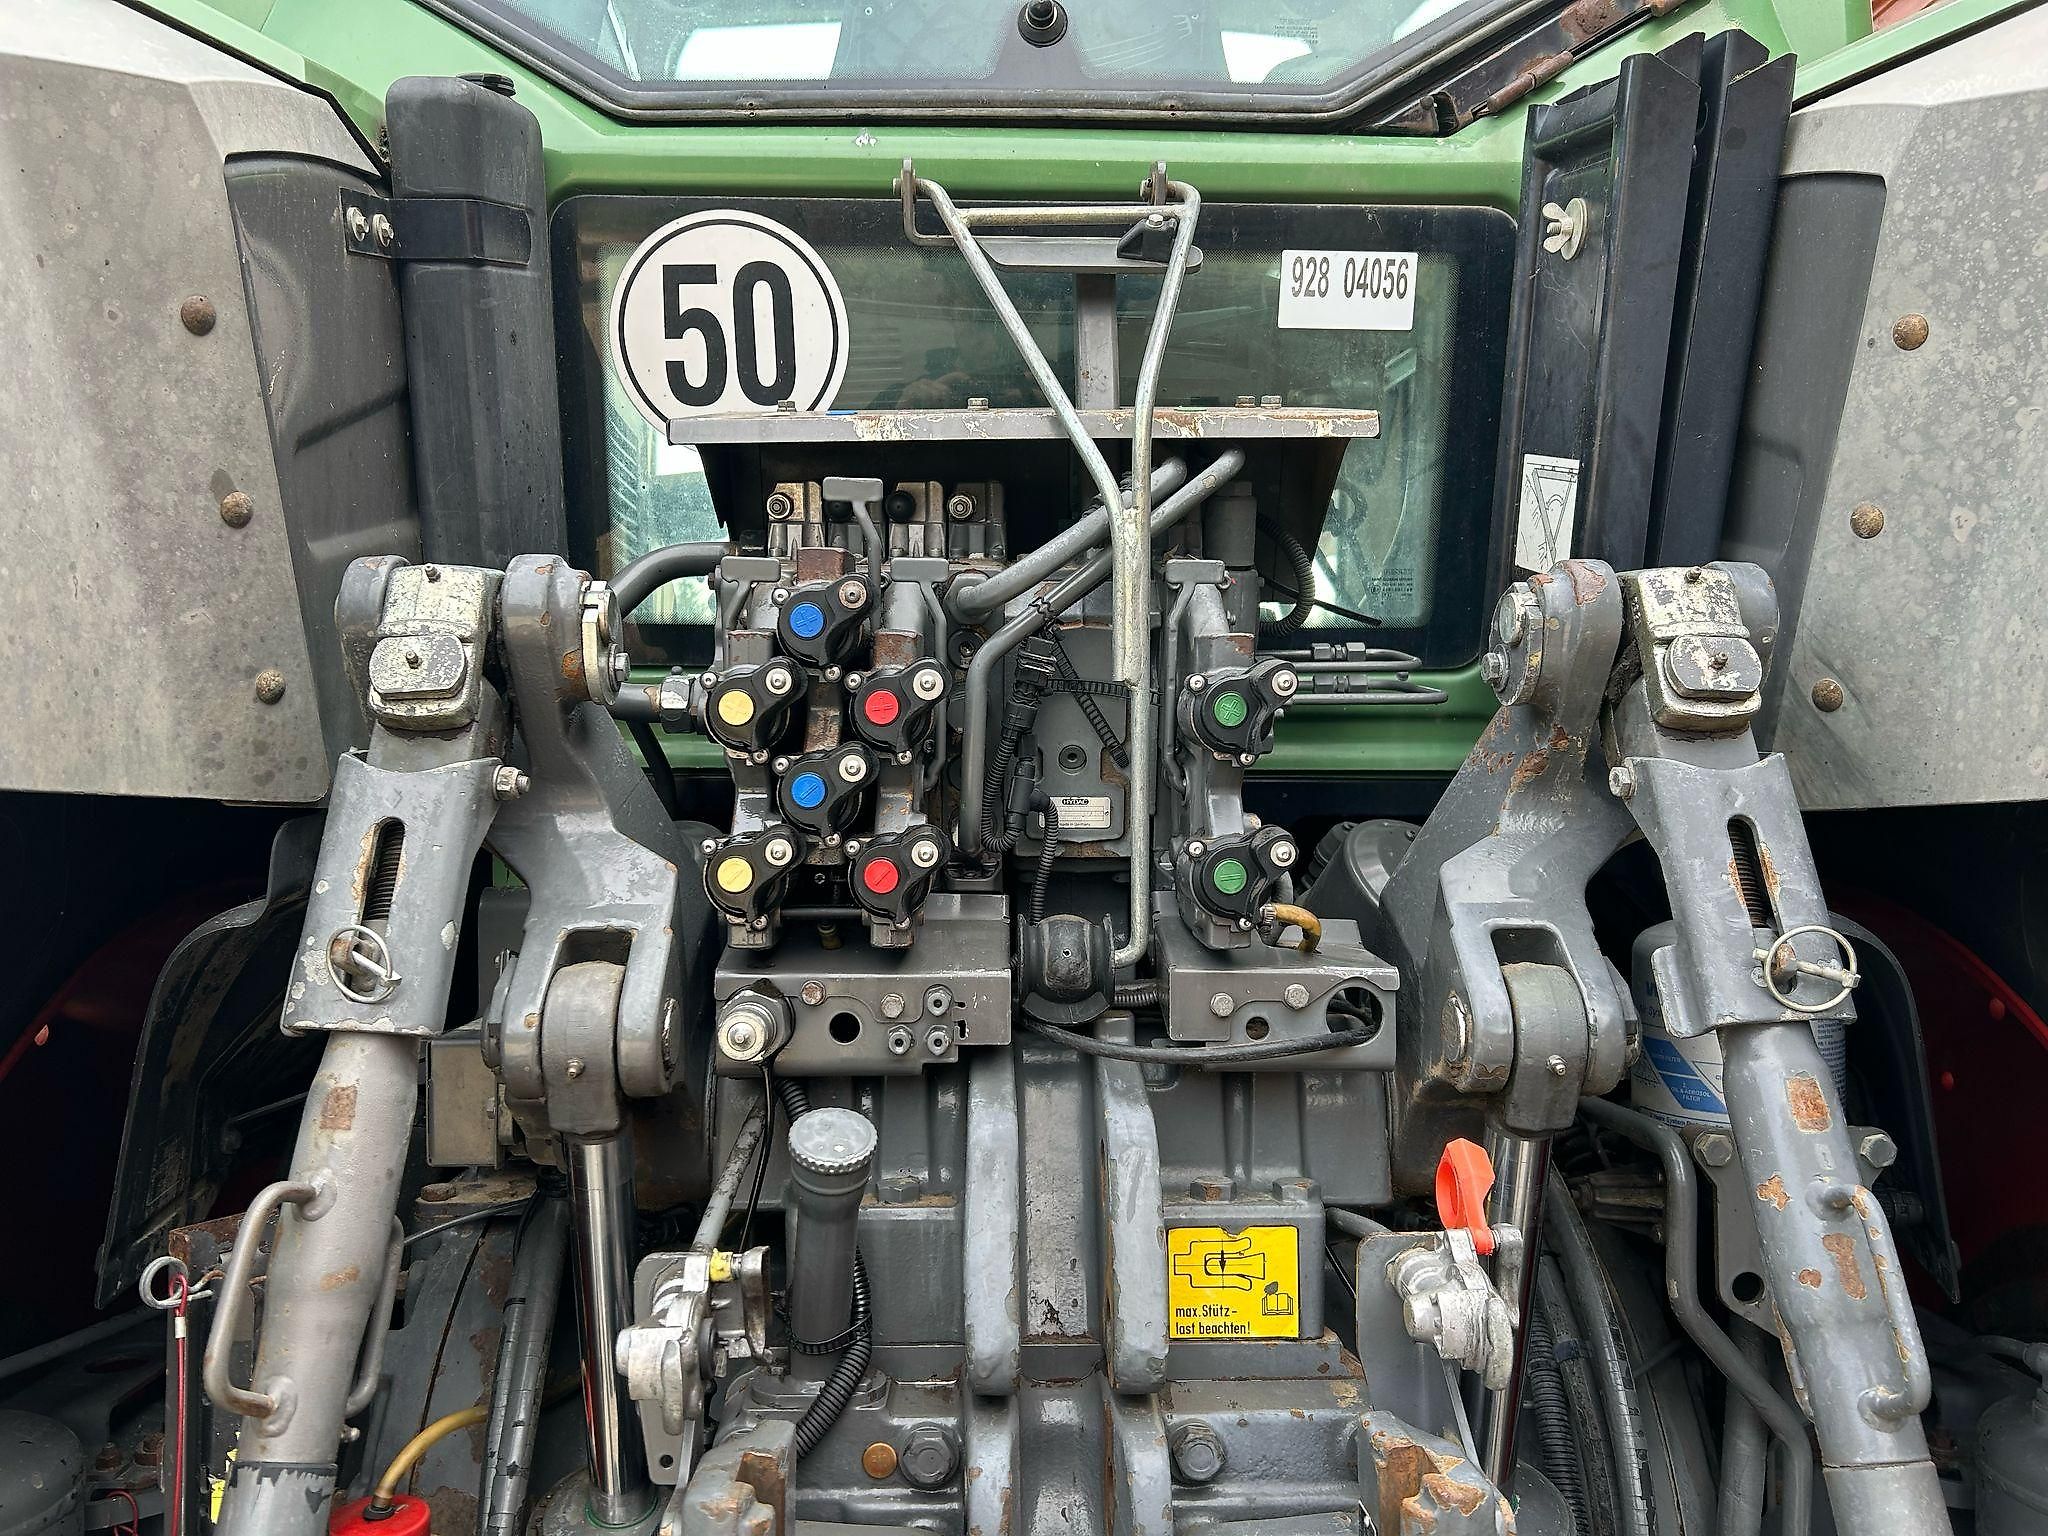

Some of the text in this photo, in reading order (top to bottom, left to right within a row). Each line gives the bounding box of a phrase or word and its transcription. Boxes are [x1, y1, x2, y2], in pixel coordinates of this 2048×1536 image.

[1291, 256, 1409, 299] 928 04056
[662, 260, 797, 407] 50
[1175, 1321, 1251, 1335] last beachten!
